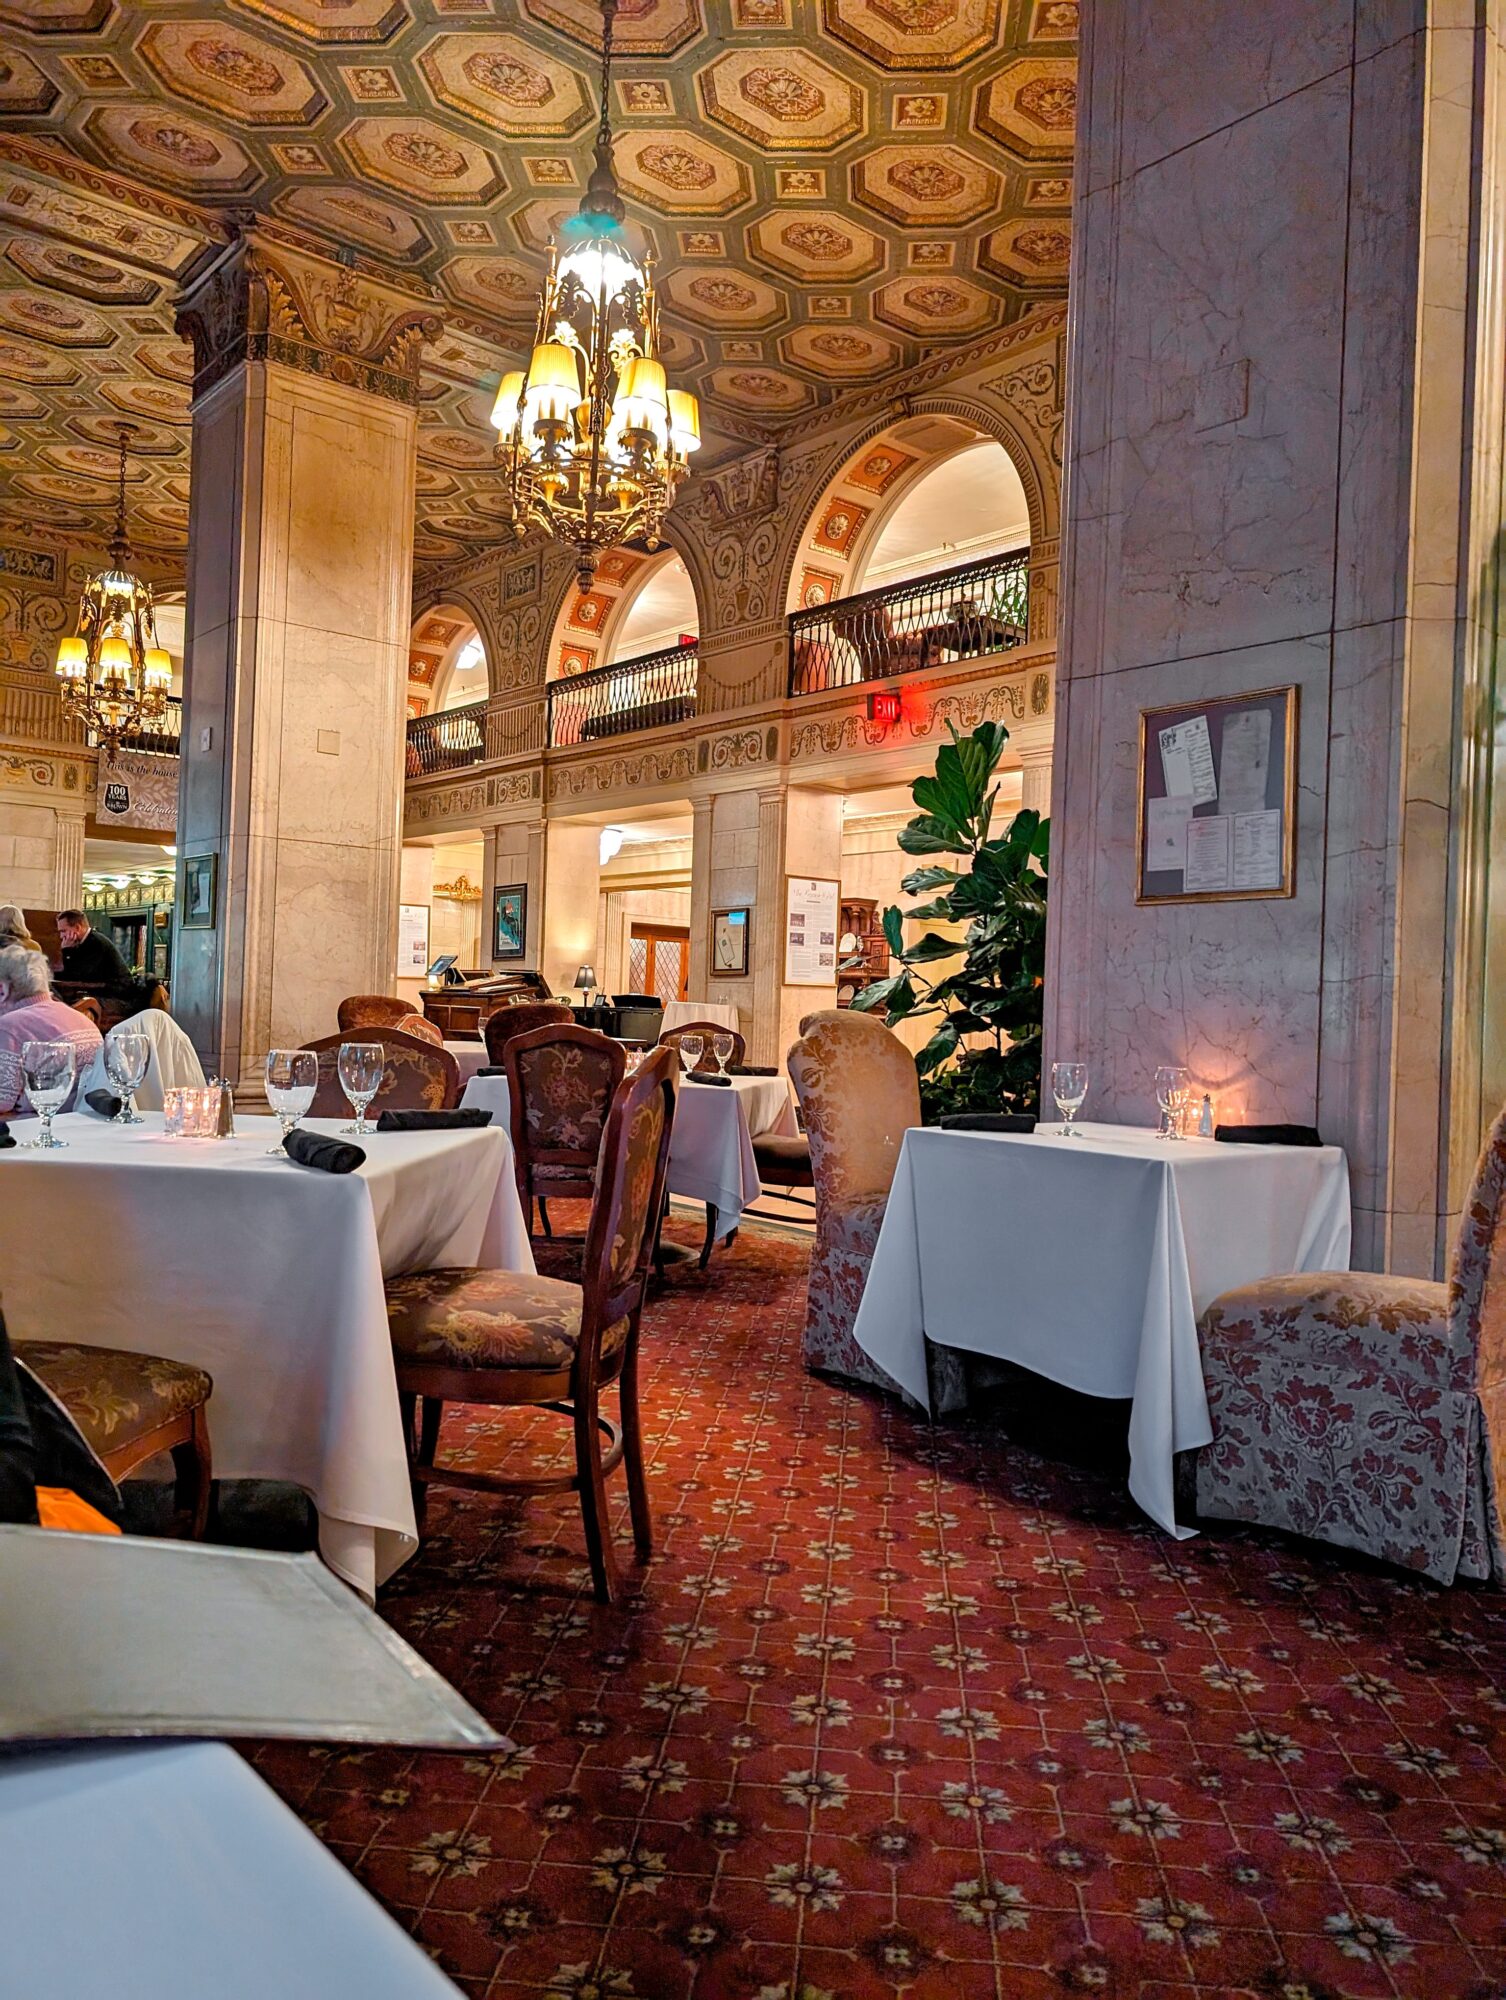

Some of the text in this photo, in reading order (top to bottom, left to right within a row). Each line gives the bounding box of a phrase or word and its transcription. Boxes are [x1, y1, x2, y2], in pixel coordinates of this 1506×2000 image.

[874, 697, 900, 719] EXIT
[127, 764, 134, 773] is
[136, 765, 151, 775] the
[152, 766, 178, 778] house
[109, 785, 126, 795] 100
